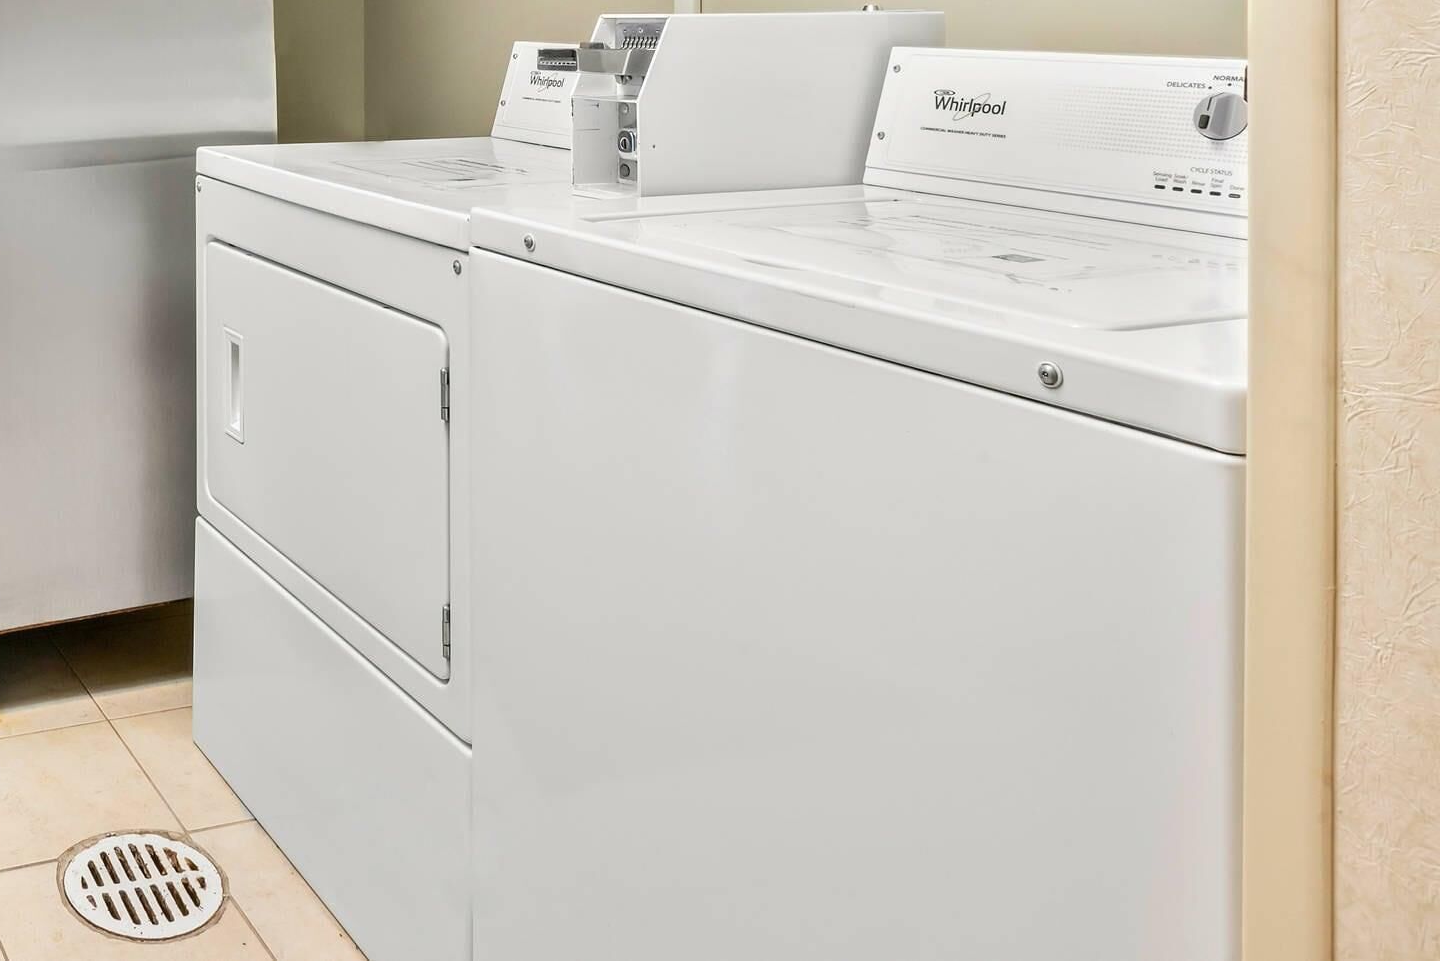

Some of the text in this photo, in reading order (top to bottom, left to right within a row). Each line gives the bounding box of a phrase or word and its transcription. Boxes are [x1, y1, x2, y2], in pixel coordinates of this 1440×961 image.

[530, 75, 564, 89] Whirlpool
[1166, 81, 1206, 89] DELICATES
[934, 96, 1007, 117] Whirlpool
[1210, 168, 1233, 176] STATUS
